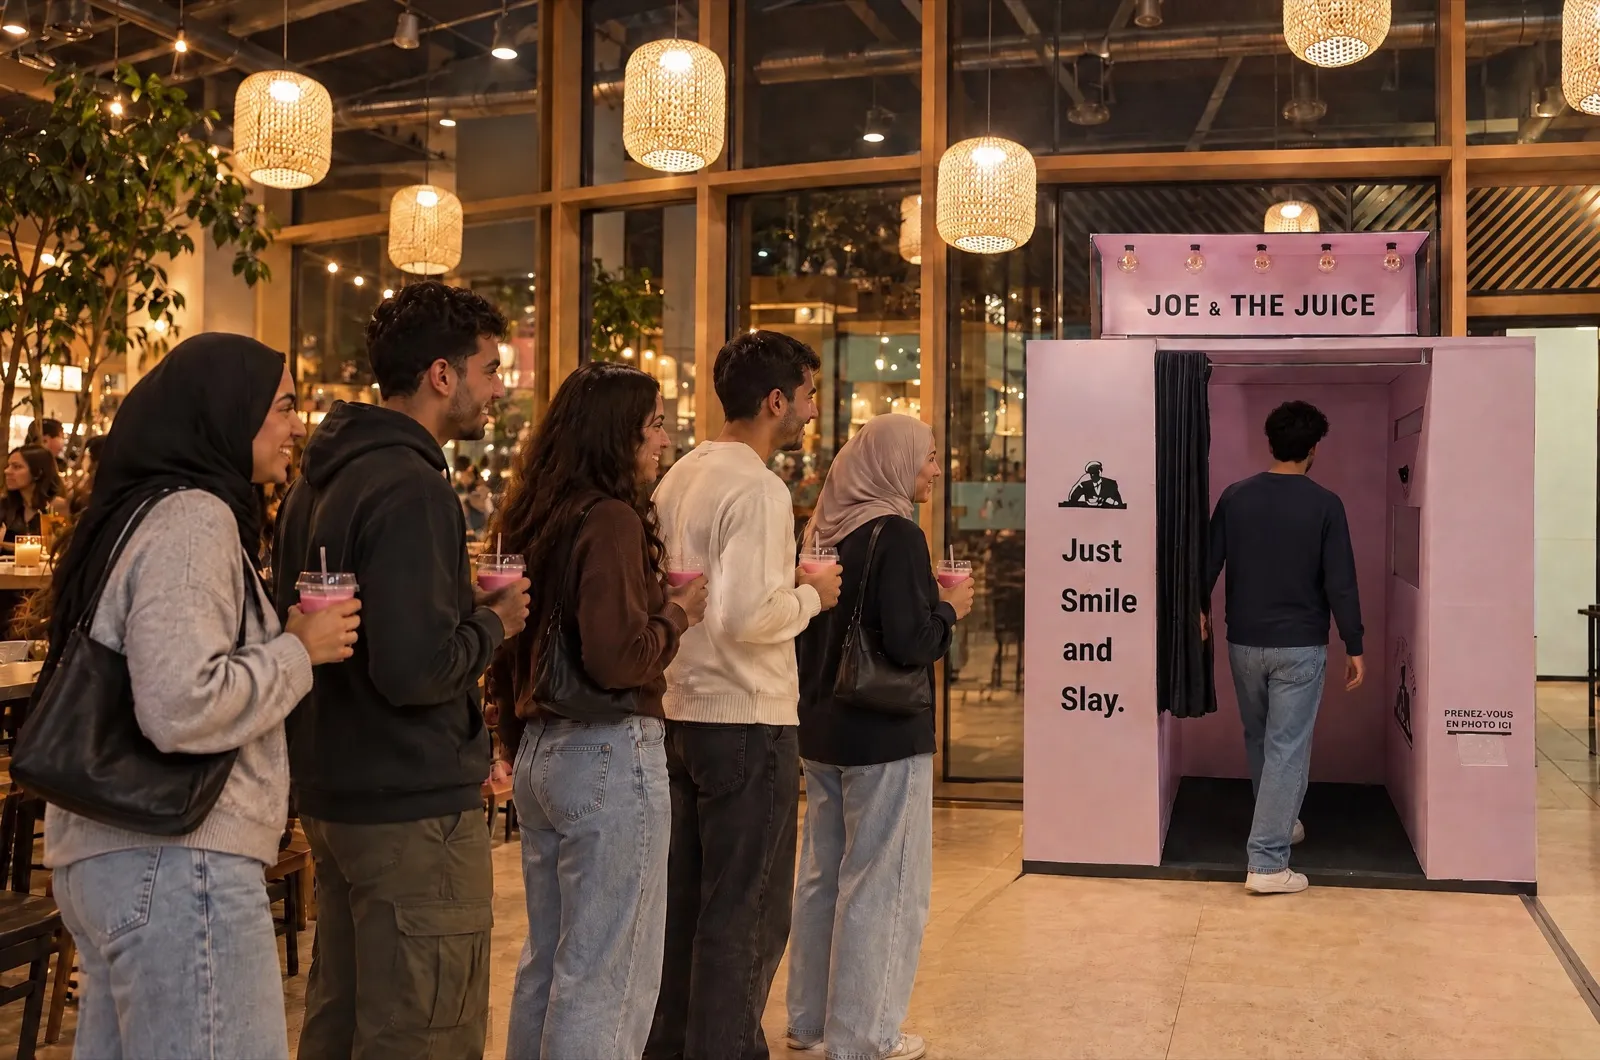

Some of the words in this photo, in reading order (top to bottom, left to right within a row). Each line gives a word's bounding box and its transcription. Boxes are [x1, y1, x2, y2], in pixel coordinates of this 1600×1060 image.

[1147, 294, 1200, 317] JOE
[1209, 301, 1221, 317] &
[1231, 294, 1285, 317] THE
[1294, 293, 1376, 317] JUICE
[1061, 537, 1123, 563] Just
[1060, 587, 1138, 614] Smile
[1062, 636, 1112, 663] and
[1060, 685, 1125, 719] Slay.
[1444, 709, 1514, 719] PRENEZ-VOUS
[1446, 720, 1459, 728] EN
[1461, 720, 1496, 729] PHOTO
[1498, 721, 1512, 729] ICI
